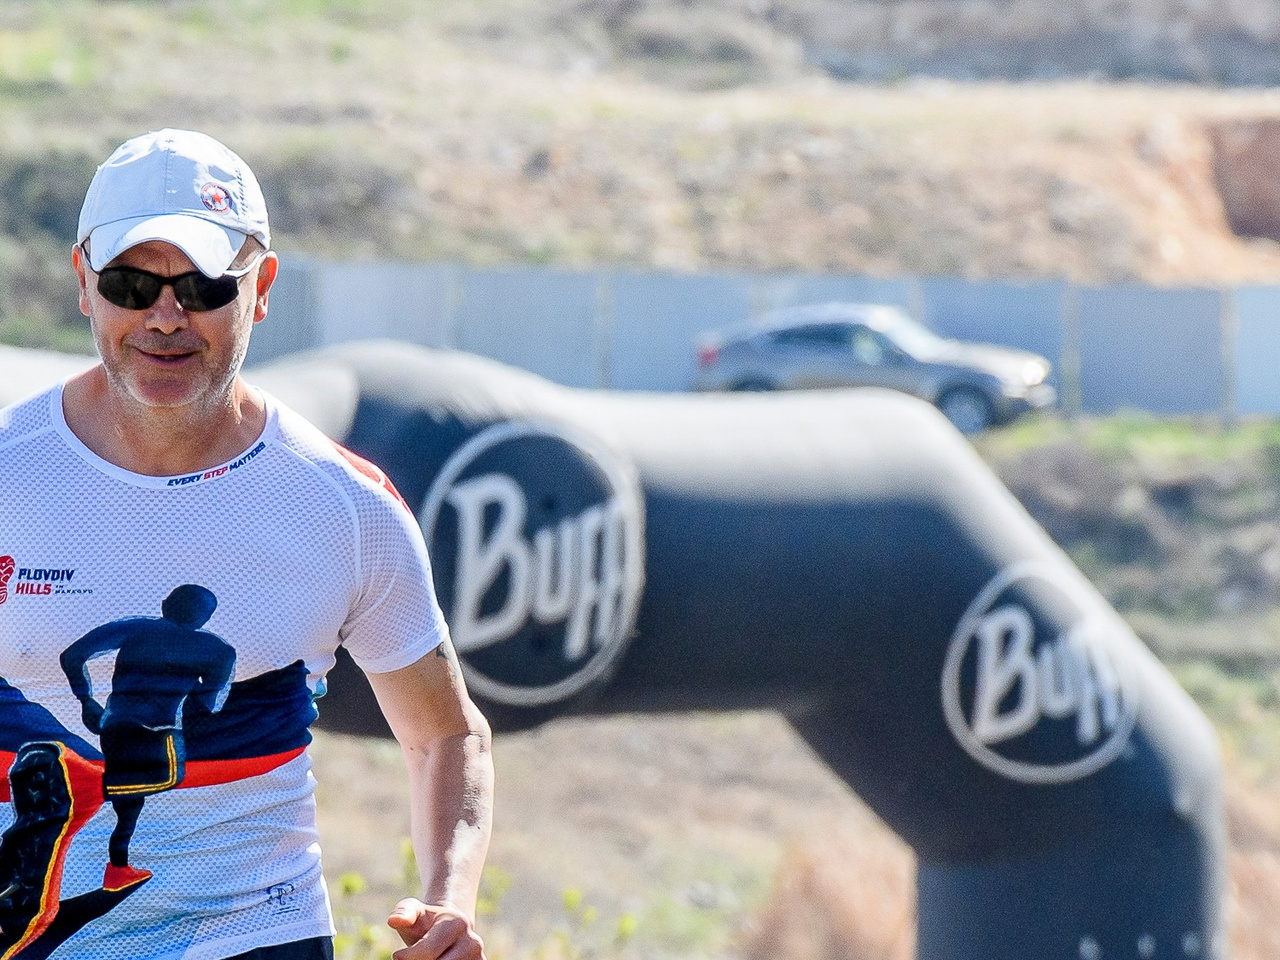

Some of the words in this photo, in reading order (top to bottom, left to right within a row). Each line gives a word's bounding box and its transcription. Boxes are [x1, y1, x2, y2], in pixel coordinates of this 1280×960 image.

[167, 474, 203, 486] EVERY
[203, 466, 228, 480] STEP
[229, 441, 266, 472] MATTERS
[18, 568, 75, 581] PLOVDIV
[15, 582, 52, 595] HILLS
